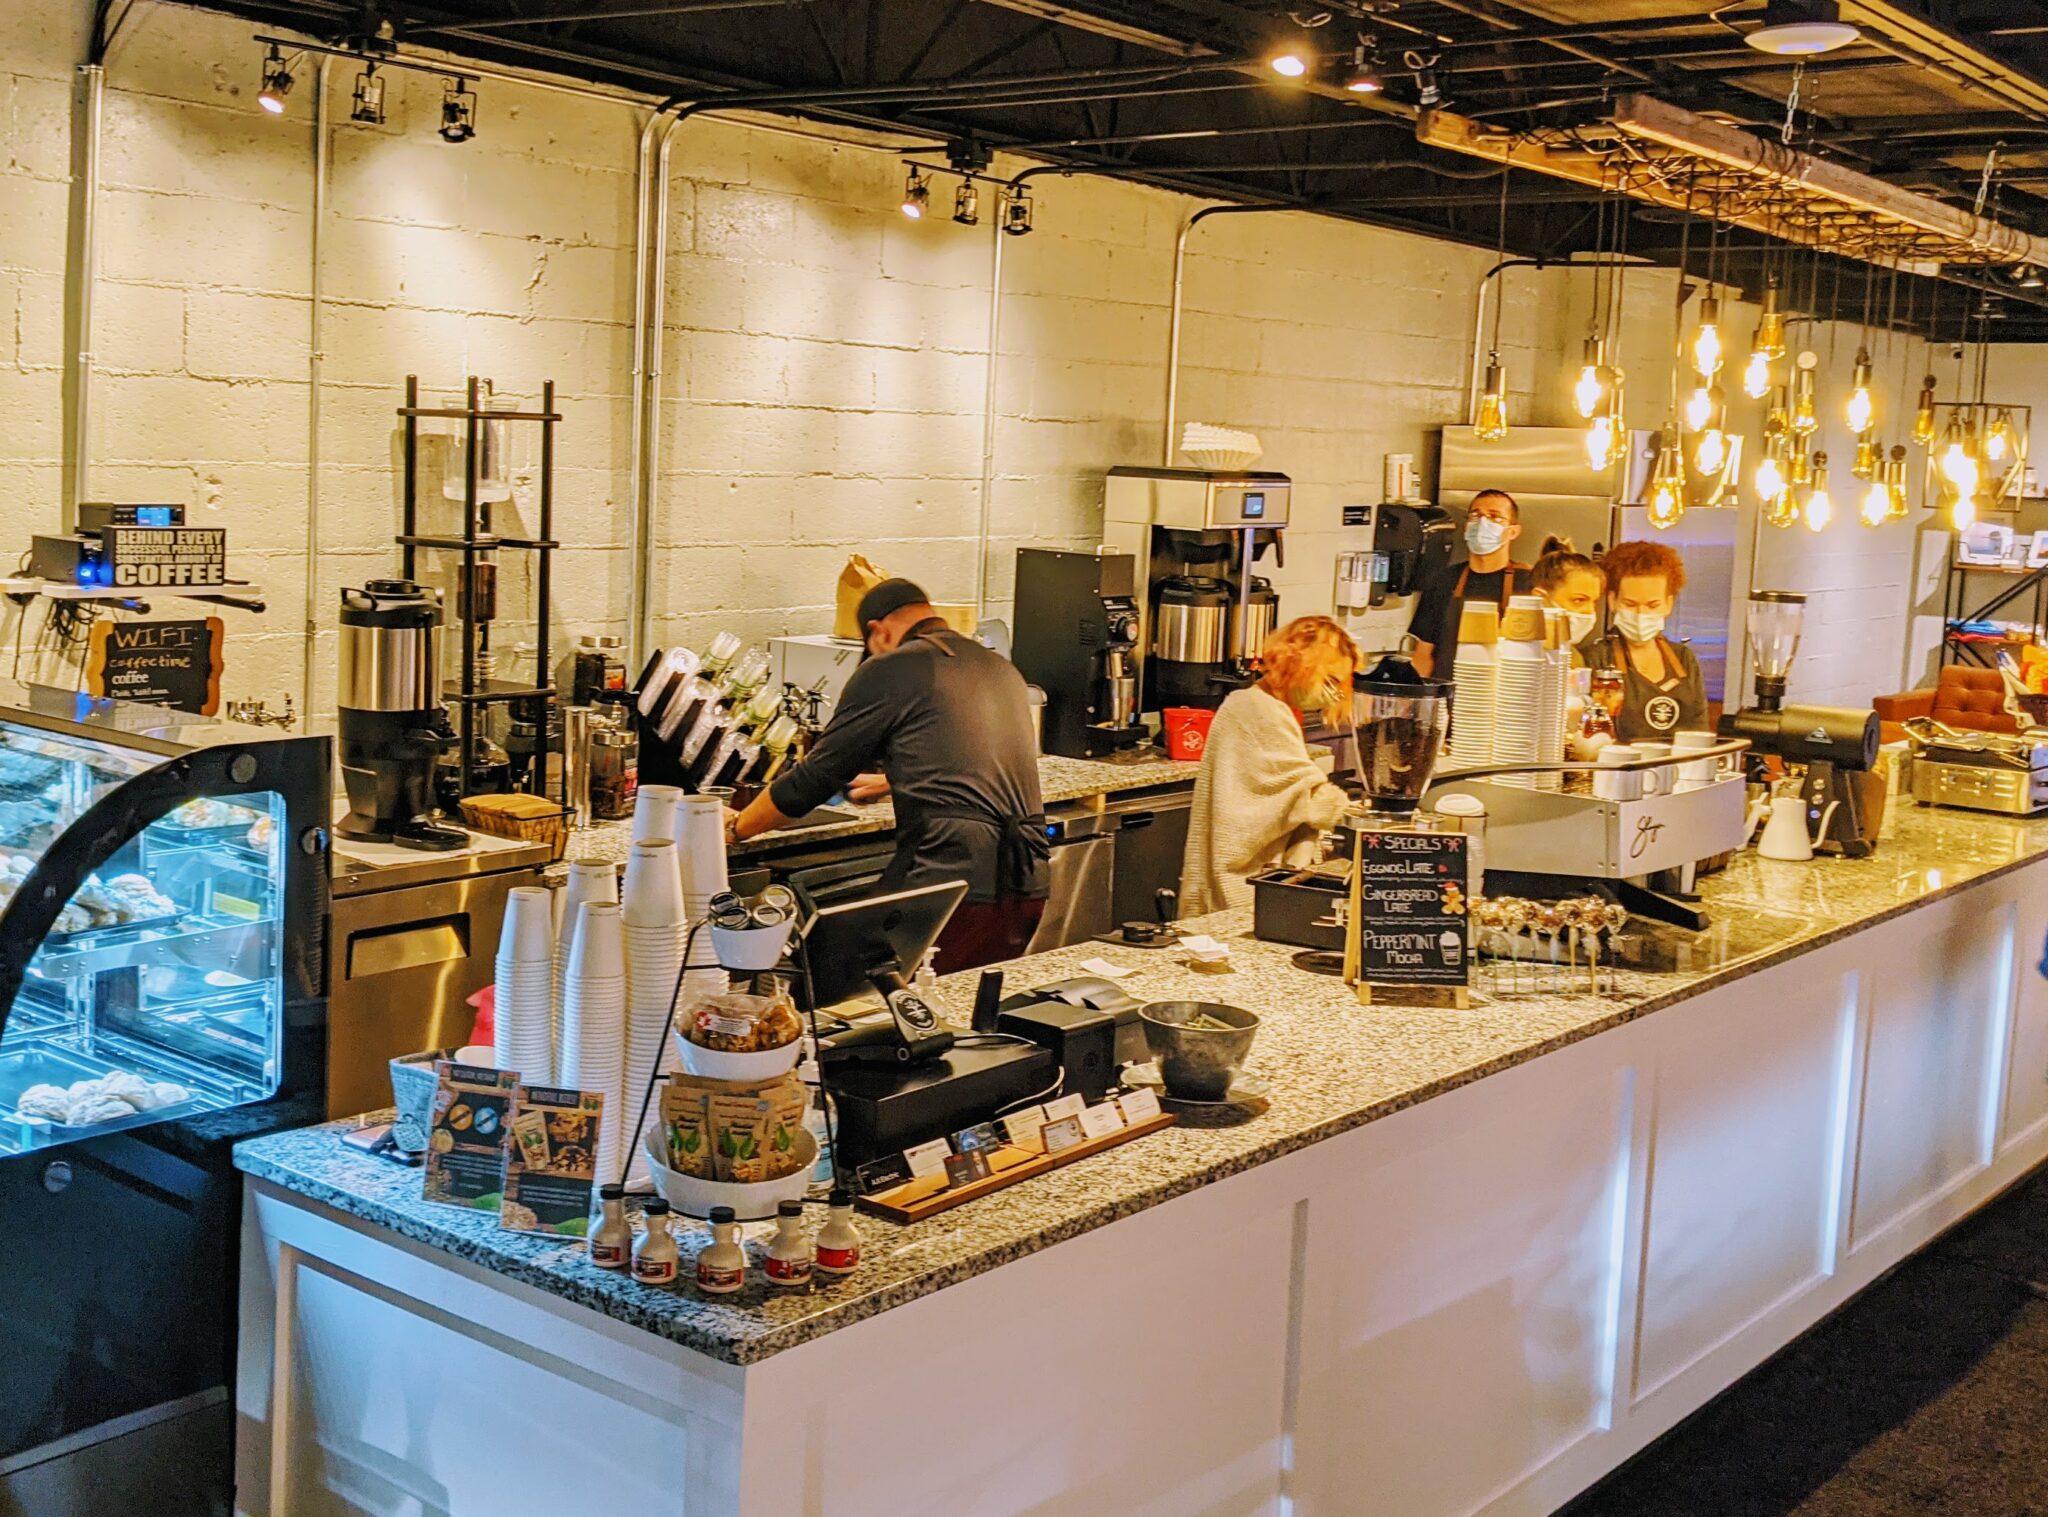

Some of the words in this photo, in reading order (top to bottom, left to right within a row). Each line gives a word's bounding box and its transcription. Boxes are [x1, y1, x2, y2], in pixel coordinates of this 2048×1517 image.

[115, 530, 174, 545] BEHIND
[176, 530, 224, 545] EVERY
[115, 545, 171, 554] SUCCESSFUL
[172, 545, 205, 554] PERSON
[206, 545, 215, 554] IS
[215, 545, 223, 554] A
[115, 554, 174, 564] SUBSTANTIAL
[175, 554, 210, 564] AMOUNT
[212, 555, 223, 564] OF
[115, 564, 223, 586] COFFEE
[1384, 835, 1442, 851] SPECIALS
[1362, 859, 1405, 875] EGGNOG
[1362, 884, 1439, 902] GINGERBREAD
[1363, 929, 1437, 949] PEPPERMINT
[1385, 950, 1424, 964] MOCHA
